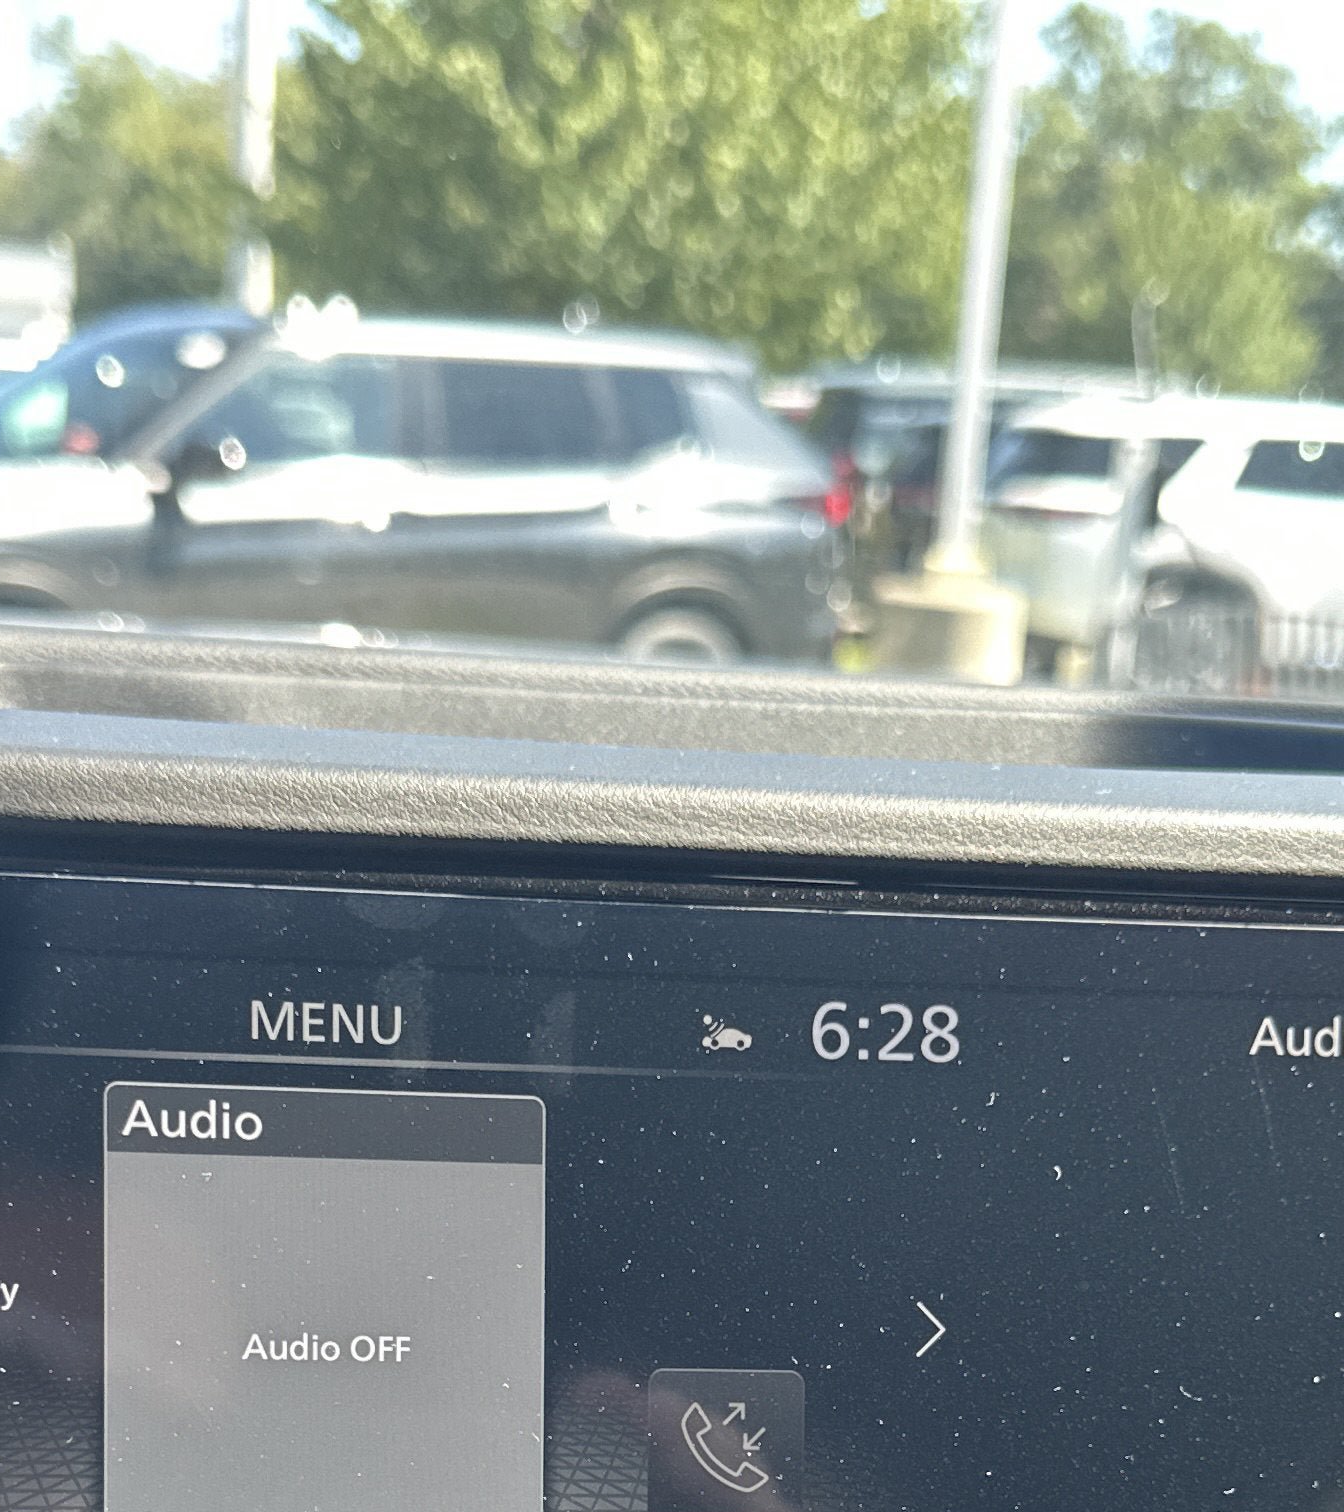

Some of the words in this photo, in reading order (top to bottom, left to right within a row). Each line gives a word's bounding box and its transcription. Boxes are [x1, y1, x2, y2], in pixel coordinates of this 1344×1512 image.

[250, 999, 403, 1045] MENU
[810, 1001, 962, 1064] 6:28
[121, 1100, 264, 1141] Audio
[242, 1333, 341, 1362] Audio
[350, 1335, 412, 1363] OFF
